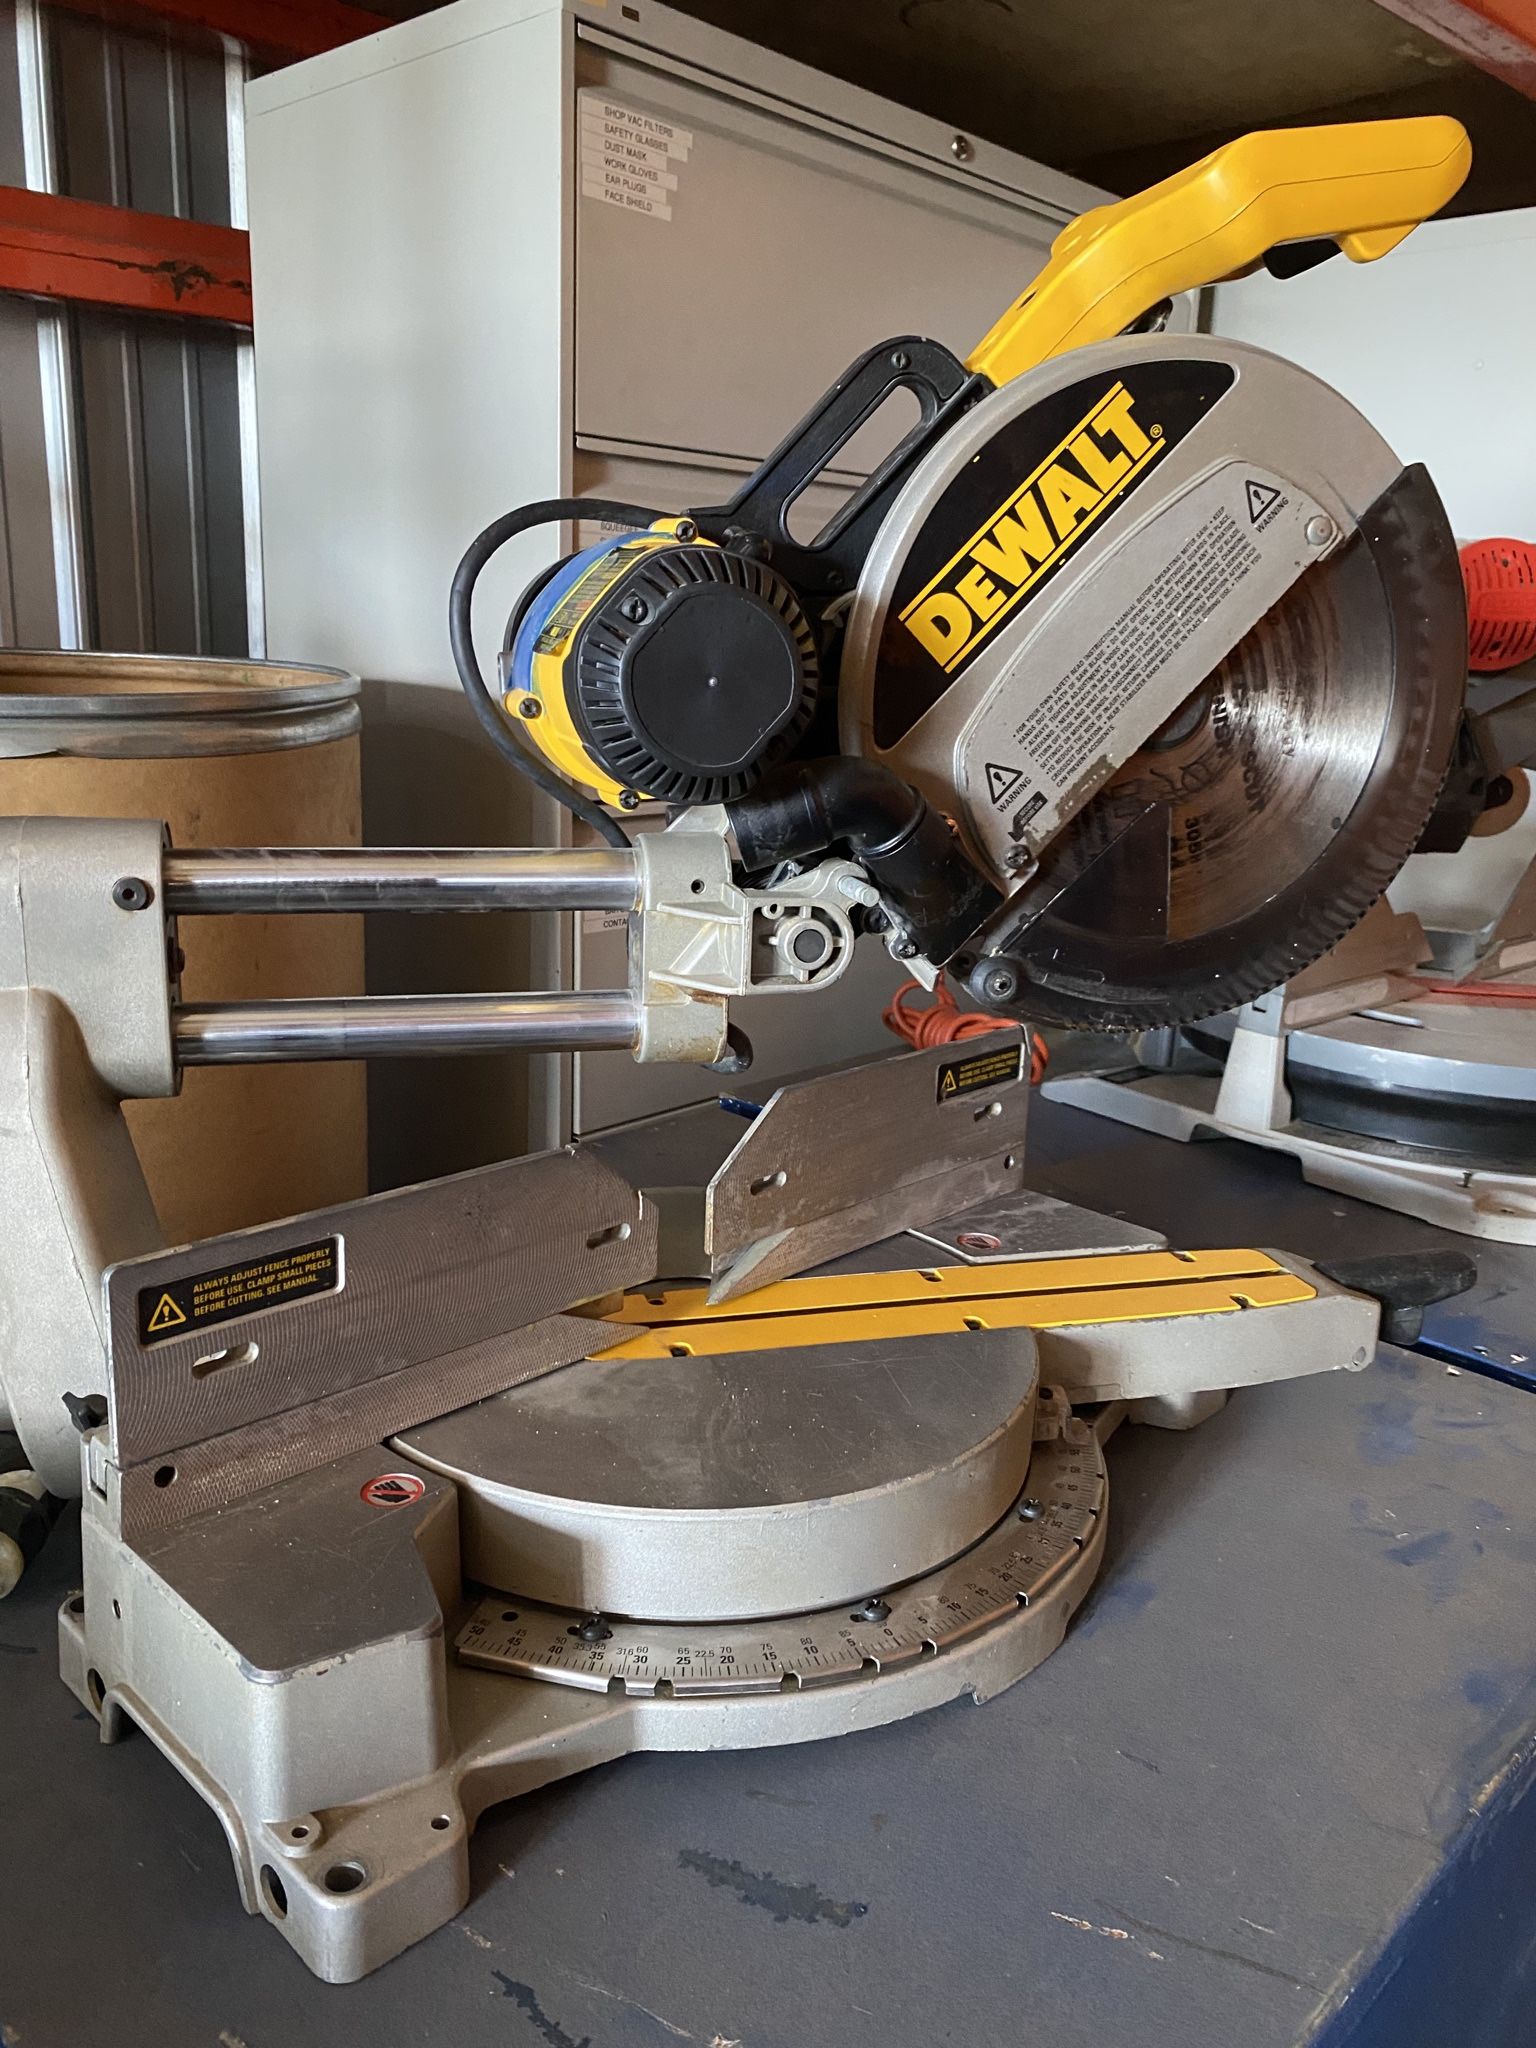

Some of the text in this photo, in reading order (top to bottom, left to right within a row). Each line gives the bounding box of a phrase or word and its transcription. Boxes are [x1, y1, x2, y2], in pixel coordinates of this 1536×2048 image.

[604, 106, 674, 138] SHOP VAC FILTERS
[604, 123, 668, 152] SAFETY GLASSES
[604, 140, 647, 161] DUST MASK
[604, 157, 658, 181] WORK GLOVES
[605, 173, 647, 194] EAR PLUGS
[604, 190, 653, 212] FACE SHIELD
[1255, 497, 1289, 533] WARNING
[904, 388, 1152, 668] DEWALT
[1025, 707, 1040, 724] YOUR
[1051, 674, 1071, 695] SAFETY
[1070, 659, 1084, 675] READ
[1083, 625, 1116, 661] INSTRUCTION
[1114, 602, 1137, 627] MANUAL
[1135, 582, 1155, 604] BEFORE
[1153, 553, 1181, 585] OPERATING
[1017, 724, 1036, 745] HANDS
[1053, 689, 1068, 705] PATH
[1129, 598, 1152, 623] OPERATE
[1163, 560, 1187, 586] WITHOUT
[1057, 706, 1075, 726] NEVER
[1073, 688, 1091, 708] REACH
[1096, 667, 1111, 684] BACK
[1148, 607, 1166, 627] NEVER
[1164, 590, 1182, 610] CROSS
[1027, 722, 1049, 746] ALWAYS
[1048, 699, 1070, 723] TIGHTEN
[1069, 664, 1103, 701] ADJUSTMENT
[1120, 624, 1139, 646] BEFORE
[1037, 743, 1052, 760] TURN
[1060, 719, 1074, 735] TOOL
[1084, 693, 1099, 709] WAIT
[1119, 652, 1136, 671] BLADE
[1142, 630, 1156, 646] STOP
[1155, 611, 1174, 632] BEFORE
[1173, 589, 1194, 613] MOVING
[1039, 743, 1064, 770] SETTINGS
[1070, 713, 1091, 737] MOVING
[1111, 657, 1143, 691] DISCONNECT
[1141, 638, 1160, 659] POWER
[1159, 619, 1178, 640] BEFORE
[1050, 753, 1076, 782] CROSSCUT
[1106, 706, 1120, 722] REAR
[1119, 677, 1146, 708] STABILIZER
[1145, 663, 1160, 679] BARS
[1158, 647, 1174, 665] MUST
[1186, 617, 1202, 635] PLACE
[1054, 744, 1074, 766] REDUCE
[1083, 720, 1096, 734] RISK
[1121, 671, 1141, 693] RETURN
[1140, 645, 1165, 672] CARRIAGE
[1180, 614, 1194, 628] FULL
[1066, 752, 1089, 777] PREVENT
[996, 776, 1032, 813] WARNING
[603, 918, 628, 928] CONTA
[193, 1248, 330, 1293] ALWAYS ADJUST FENCE PROPERLY
[193, 1288, 225, 1305] BEFORE
[247, 1275, 276, 1290] CLAMP
[277, 1265, 303, 1281] SMALL
[305, 1258, 332, 1273] PIECES
[194, 1300, 226, 1317] BEFORE
[267, 1283, 281, 1296] SEE
[947, 1602, 962, 1612] 10
[469, 1625, 485, 1636] 50
[918, 1616, 928, 1624] 5
[507, 1637, 523, 1647] 45
[515, 1628, 528, 1637] 45
[555, 1636, 567, 1645] 50
[846, 1638, 856, 1647] 5
[883, 1628, 893, 1637] 0
[548, 1645, 563, 1655] 40
[588, 1651, 605, 1660] 35
[636, 1645, 649, 1654] 60
[677, 1646, 690, 1655] 65
[719, 1646, 732, 1654] 70
[760, 1643, 773, 1652] 75
[762, 1652, 777, 1661] 15
[804, 1645, 819, 1655] 10
[633, 1655, 648, 1664] 30
[676, 1656, 691, 1665] 25
[719, 1655, 734, 1664] 20
